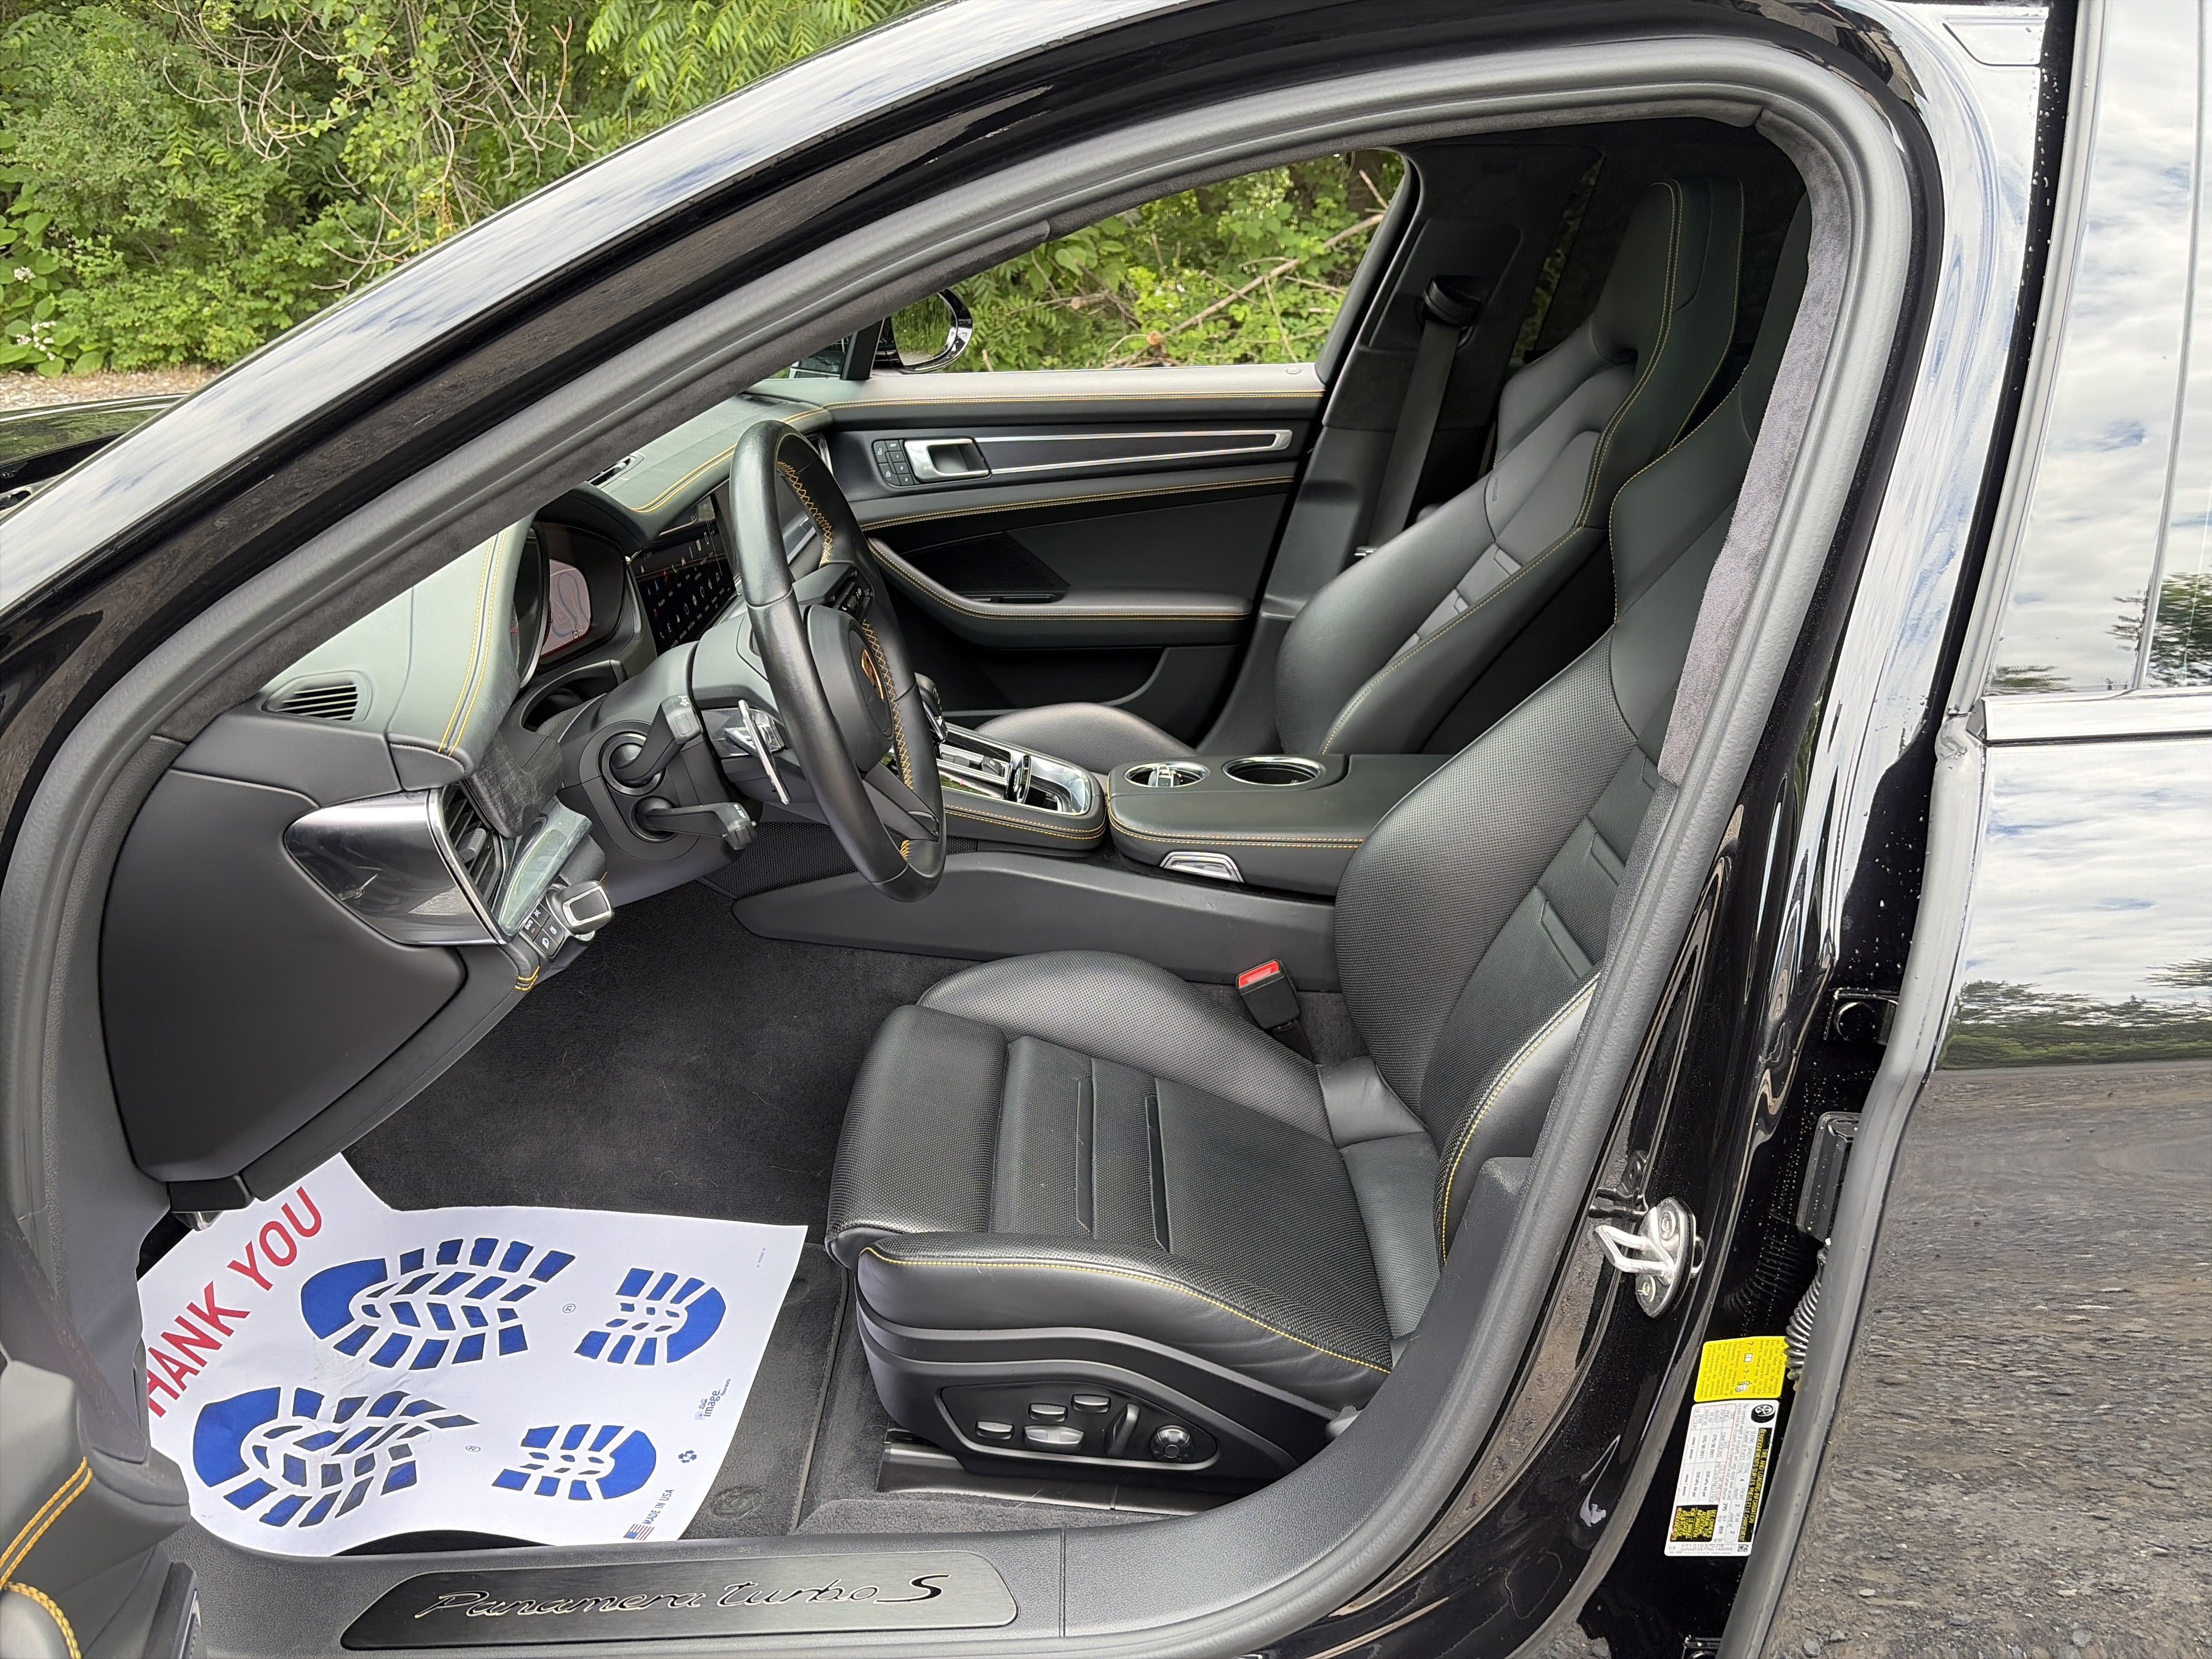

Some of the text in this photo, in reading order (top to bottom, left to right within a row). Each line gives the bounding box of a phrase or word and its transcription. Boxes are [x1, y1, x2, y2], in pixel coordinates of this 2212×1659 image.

[147, 1186, 322, 1418] HANK YOU
[703, 1390, 720, 1417] image
[1754, 1471, 1763, 1492] LOADING
[642, 1510, 661, 1525] MADE
[659, 1489, 674, 1501] USA
[1748, 1493, 1759, 1523] INFORMATION
[414, 1573, 952, 1619] Panamera turbo S
